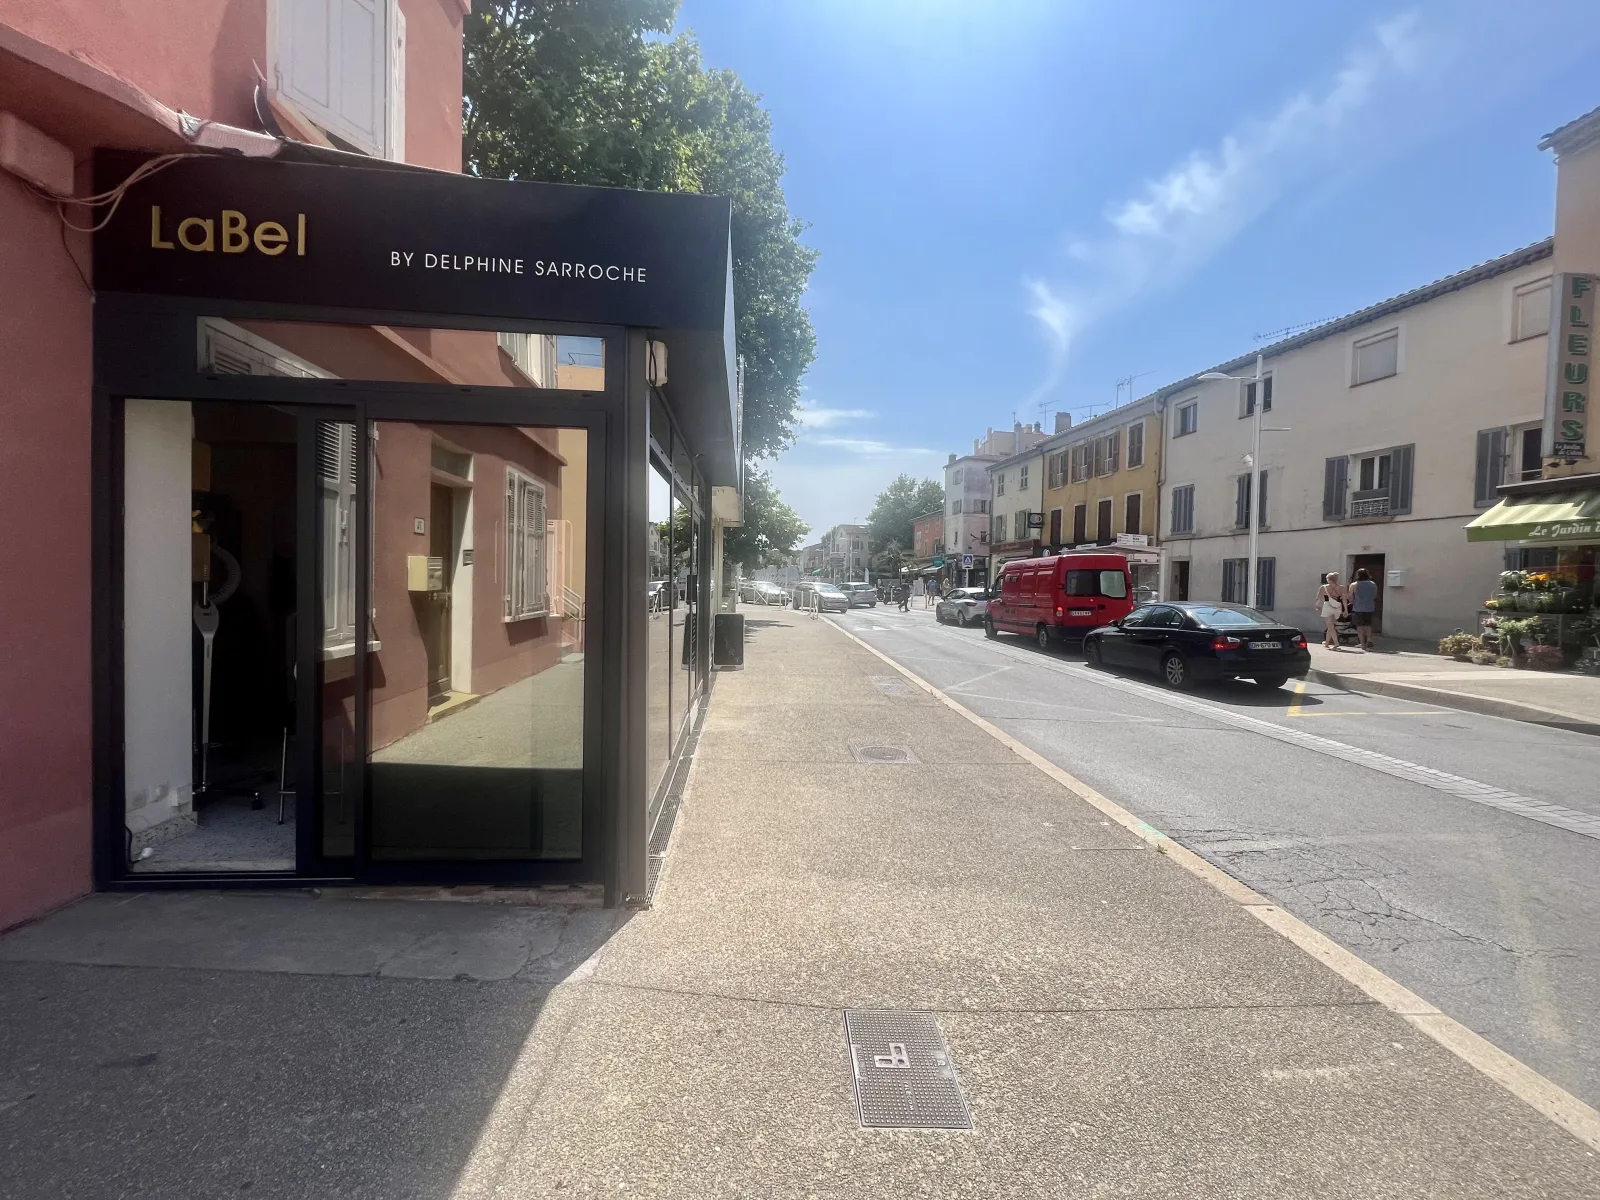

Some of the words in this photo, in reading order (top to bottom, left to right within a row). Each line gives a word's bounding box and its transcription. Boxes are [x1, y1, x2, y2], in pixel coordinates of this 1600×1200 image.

[151, 205, 306, 256] LaBel
[390, 250, 414, 268] BY
[424, 253, 524, 275] DELPHINE
[534, 260, 647, 283] SARROCHE
[1560, 275, 1592, 441] FLEURS
[1528, 525, 1547, 537] Le
[1551, 522, 1591, 537] Jardin
